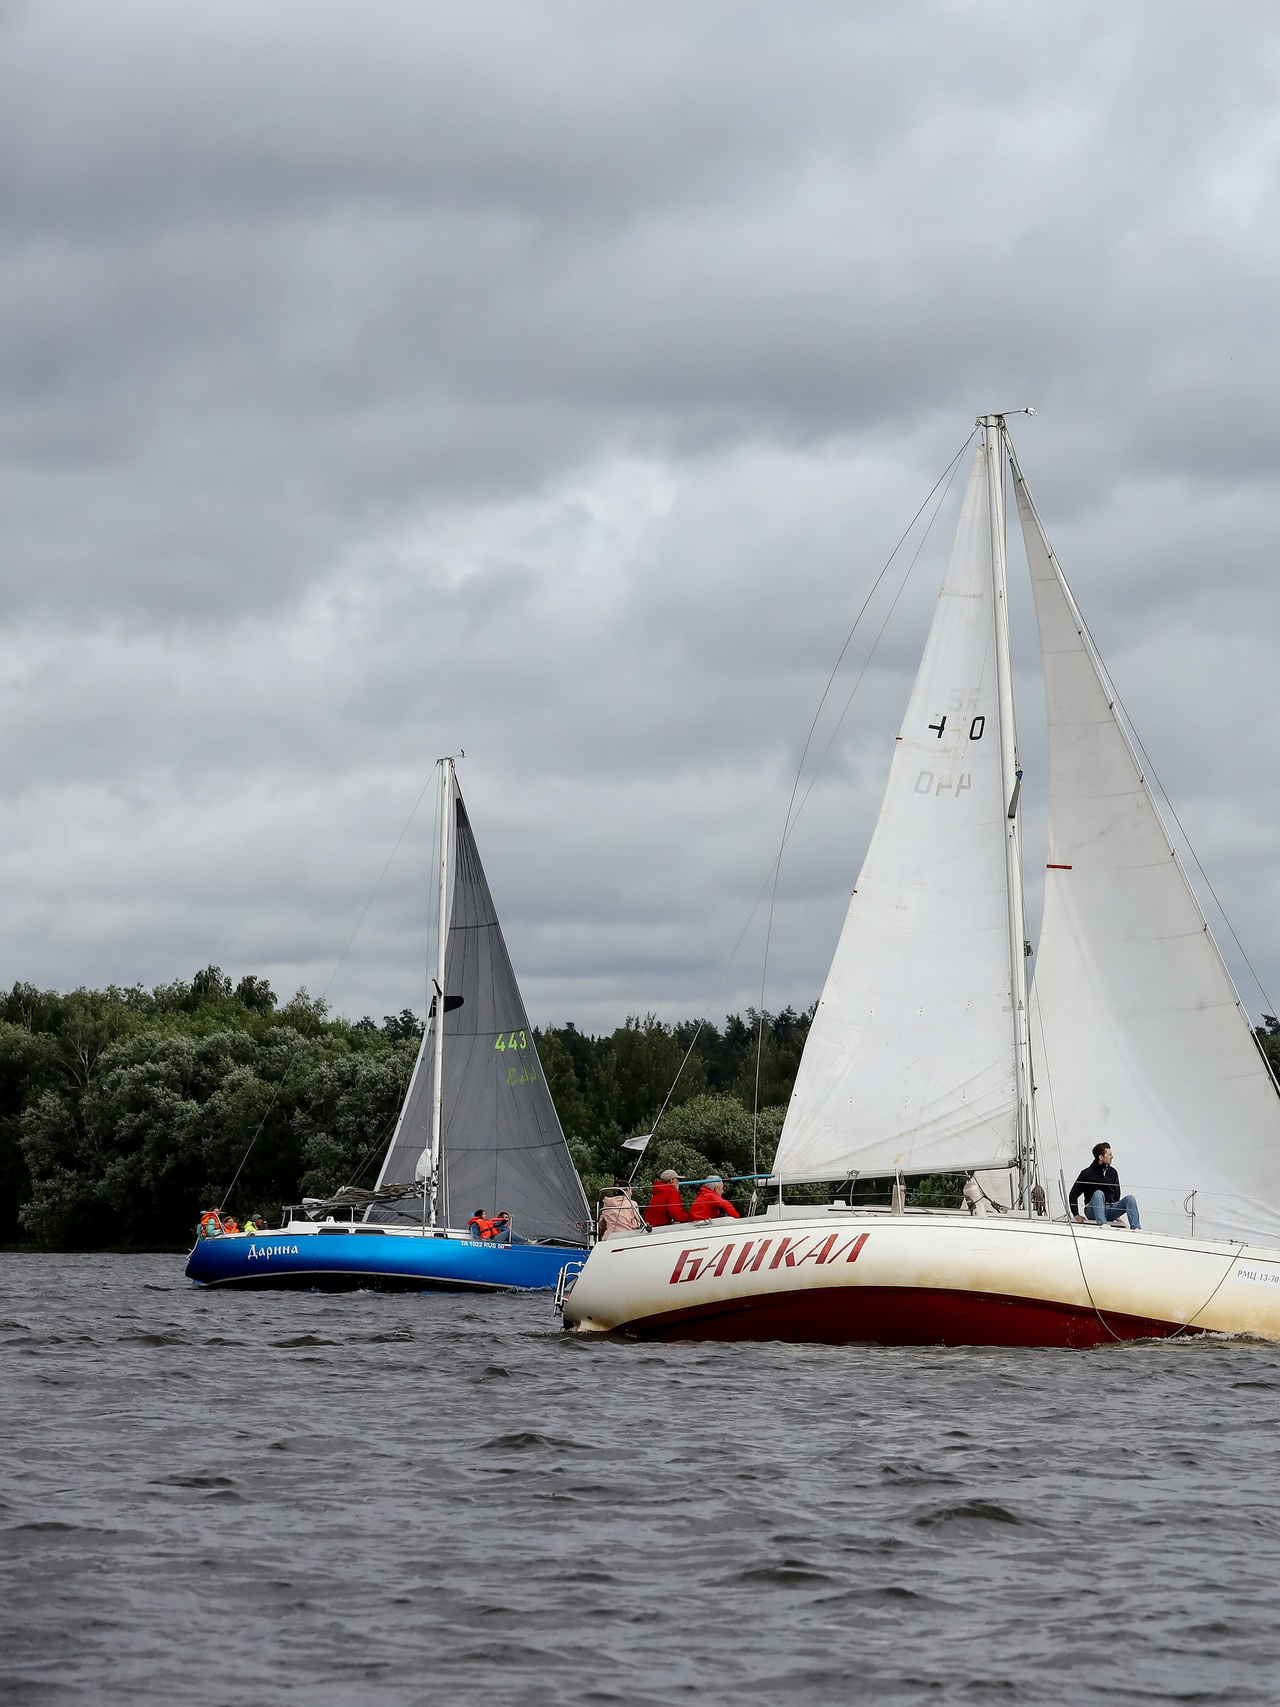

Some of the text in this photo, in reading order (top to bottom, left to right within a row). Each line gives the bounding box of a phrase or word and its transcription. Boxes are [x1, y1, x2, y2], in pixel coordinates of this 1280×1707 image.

[494, 1030, 527, 1052] 443
[247, 1244, 299, 1260] Дарина
[669, 1233, 870, 1284] БАЙКАЛ
